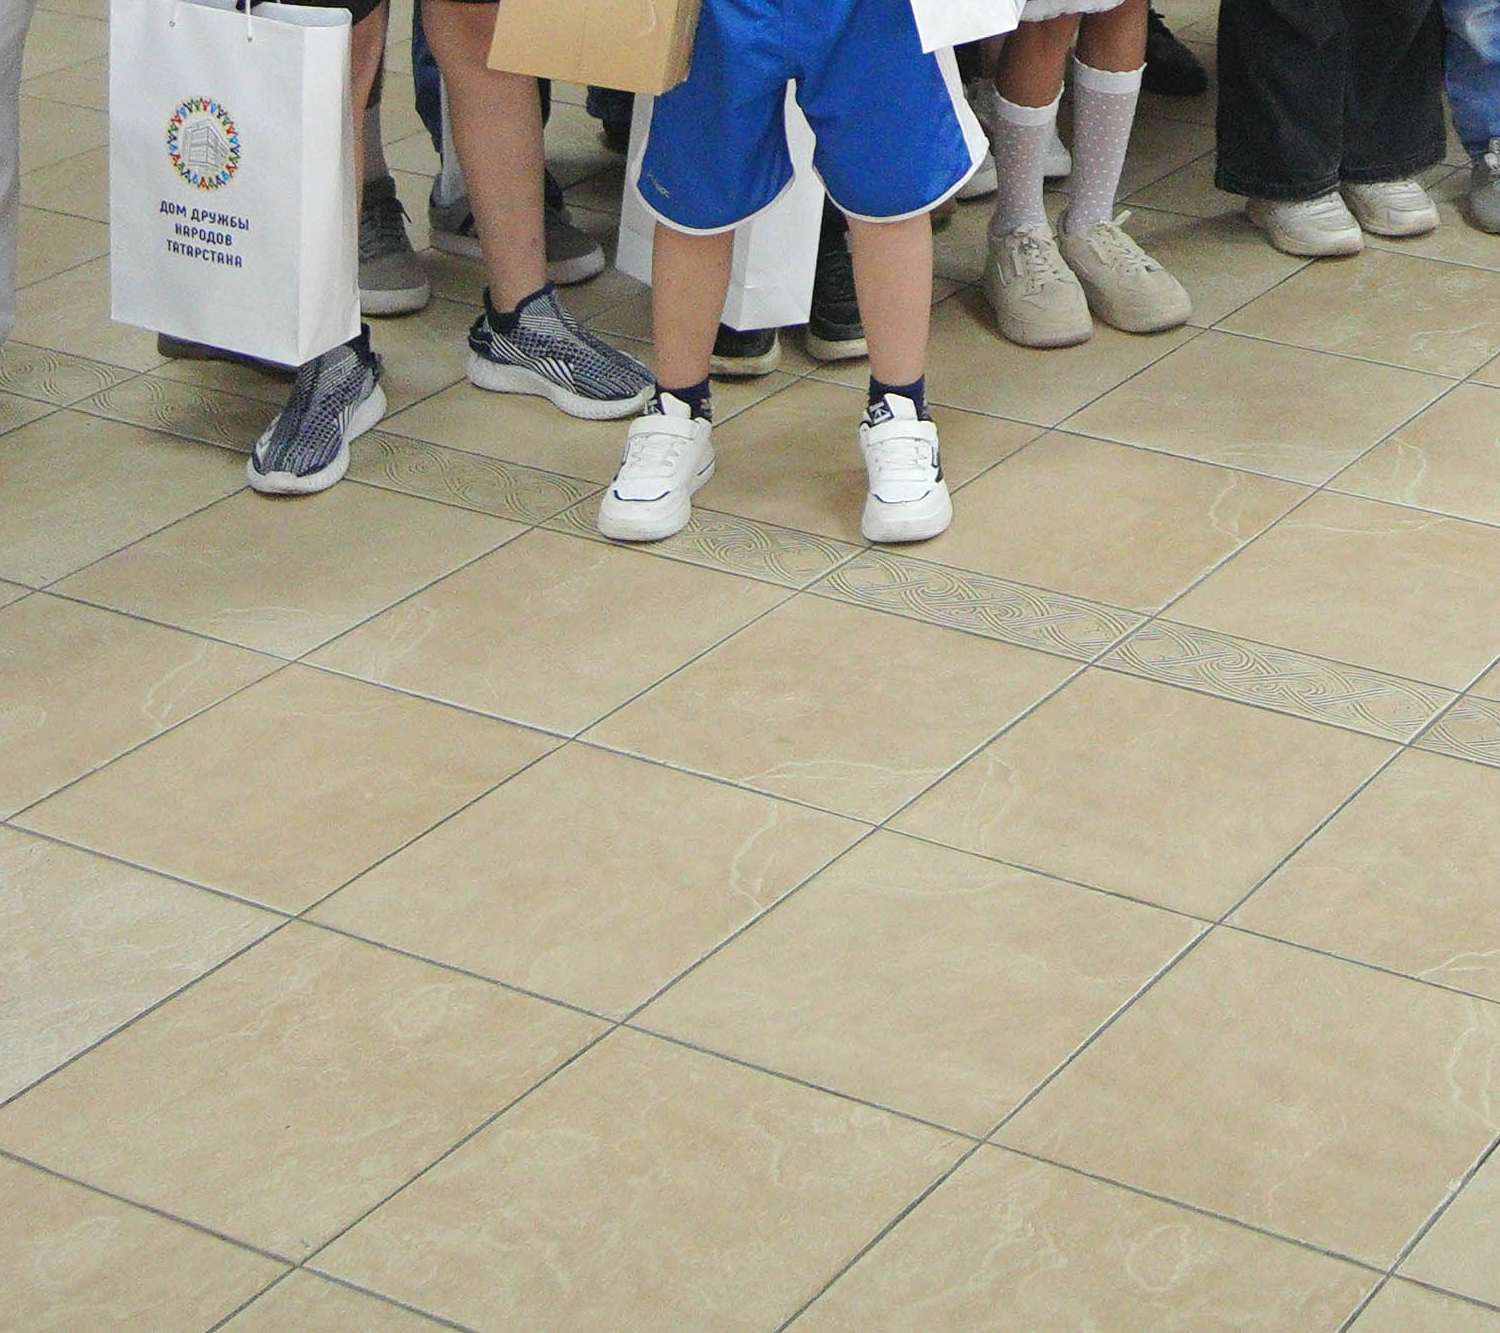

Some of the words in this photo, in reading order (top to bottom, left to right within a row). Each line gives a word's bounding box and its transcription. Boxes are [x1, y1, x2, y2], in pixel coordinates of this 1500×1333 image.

[160, 200, 187, 218] ДОМ
[191, 208, 250, 230] ДРУЖБЫ
[174, 223, 233, 247] НАРОДОВ
[166, 239, 243, 268] ТАТАРСТАНА
